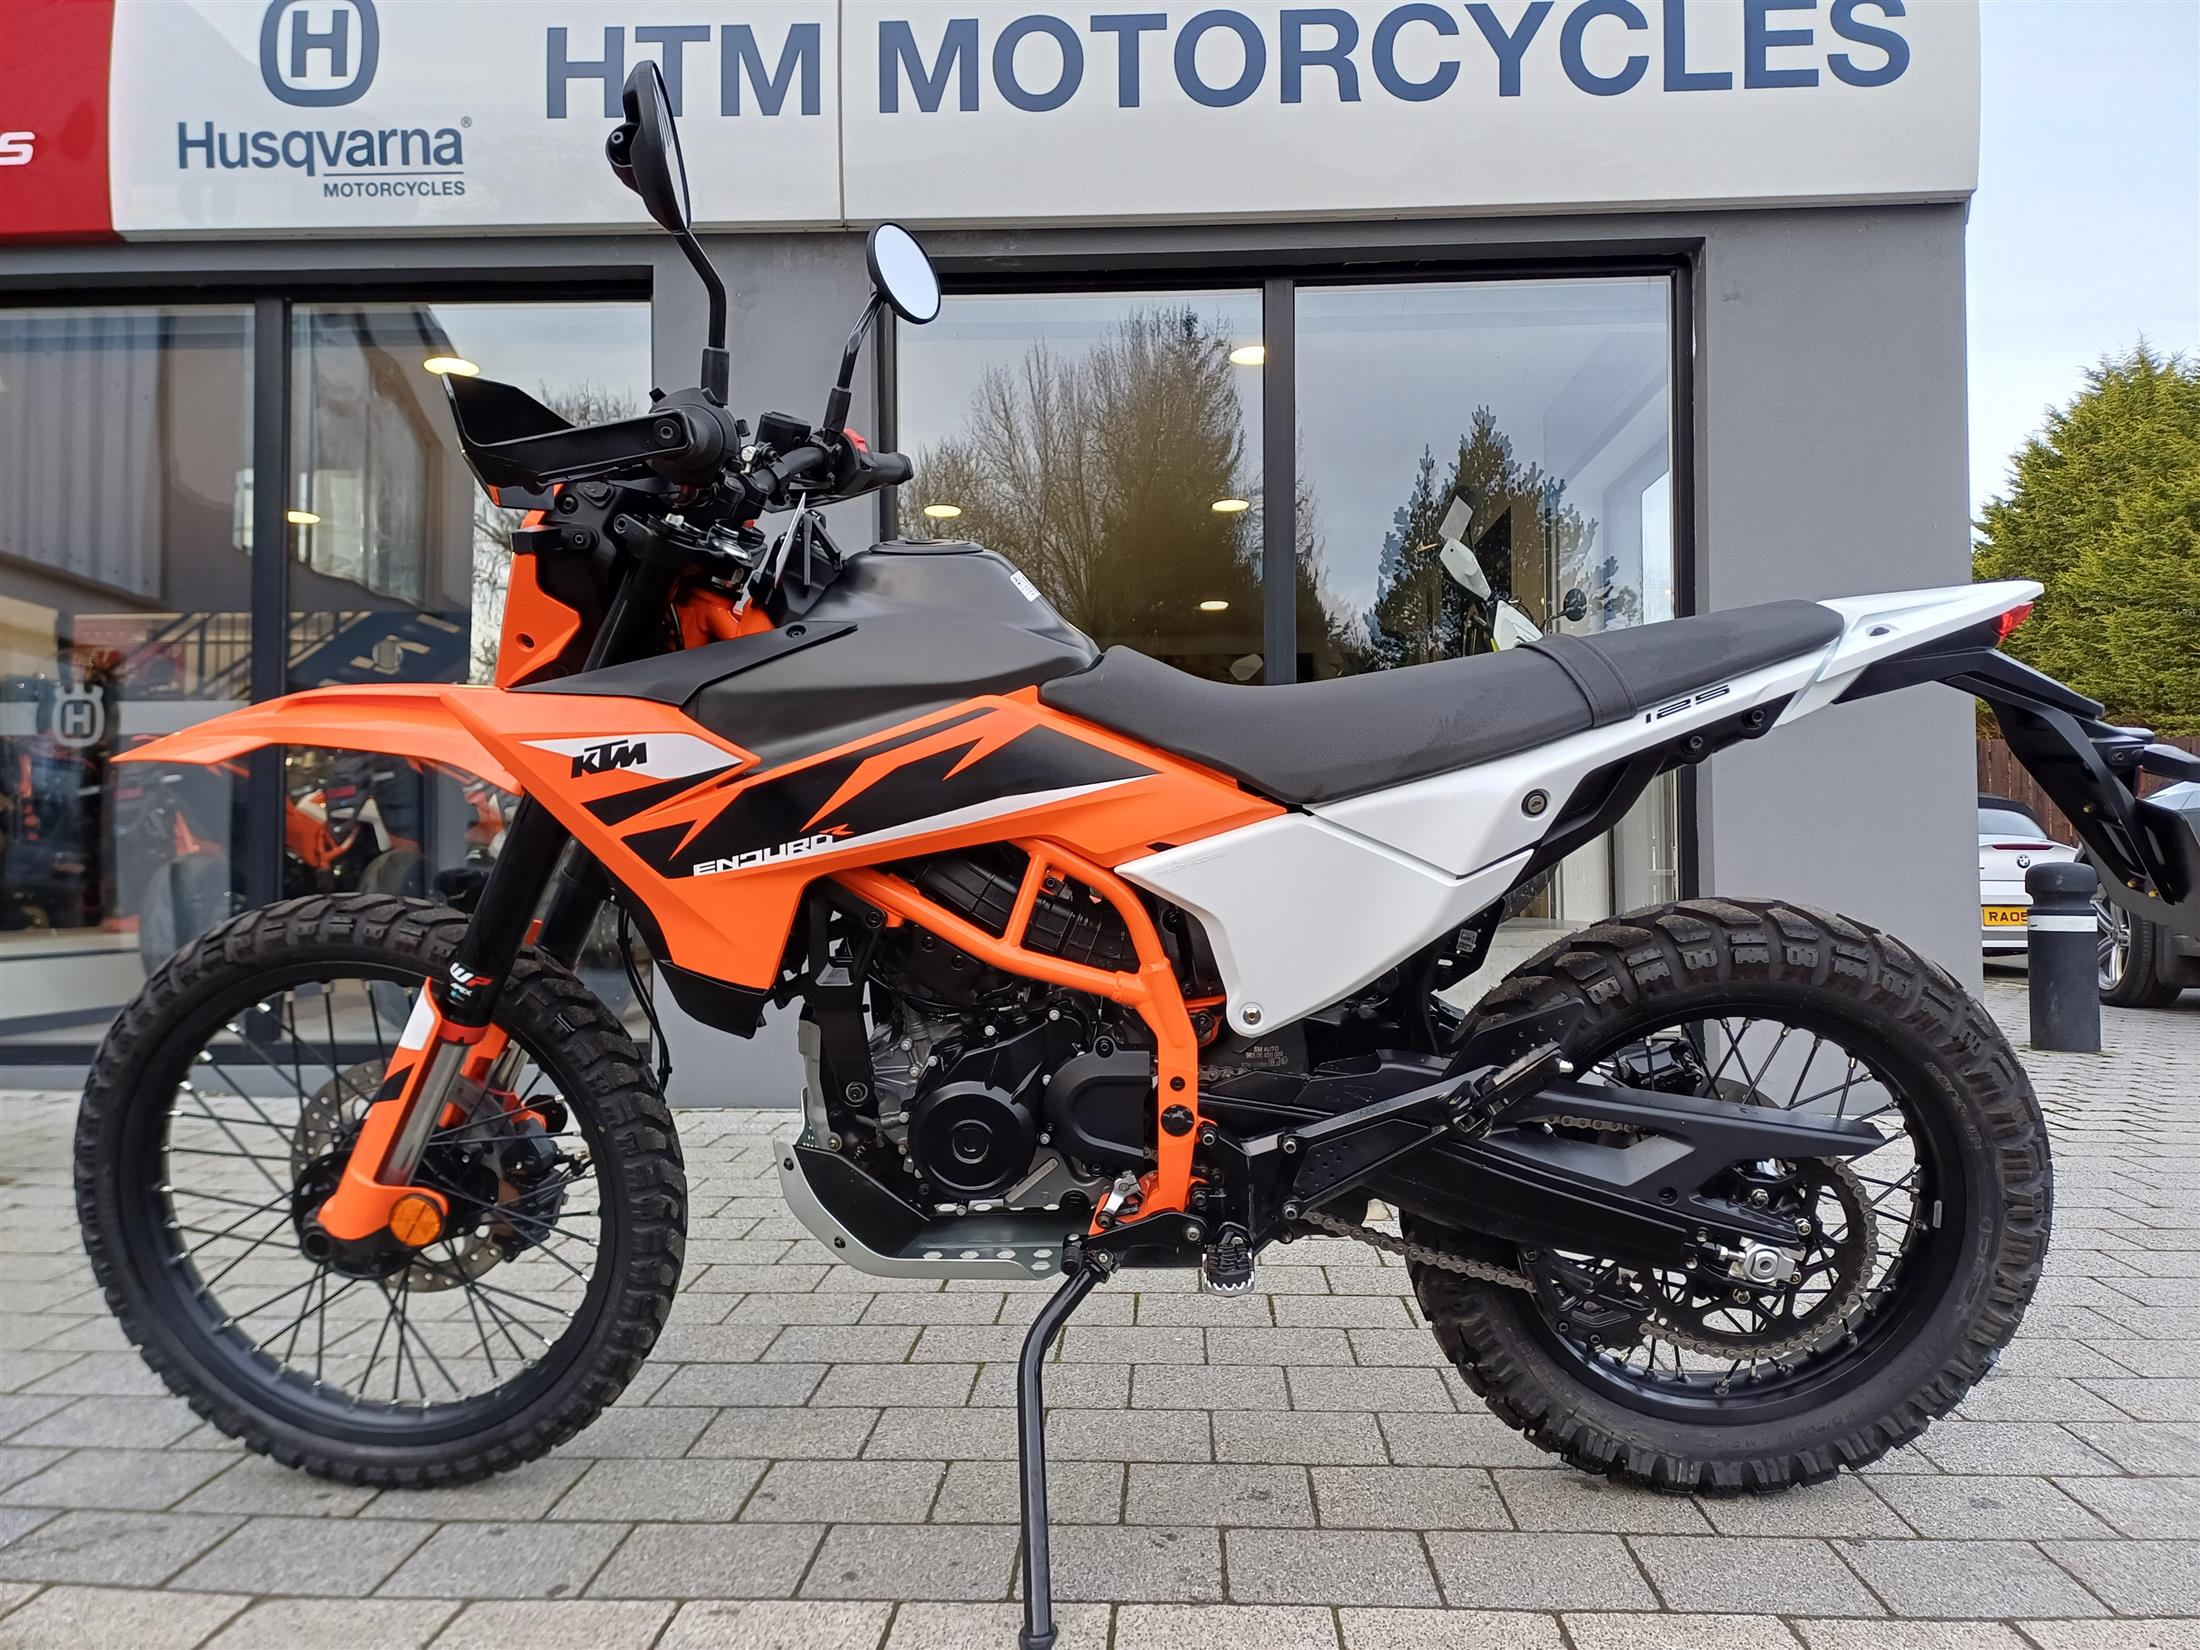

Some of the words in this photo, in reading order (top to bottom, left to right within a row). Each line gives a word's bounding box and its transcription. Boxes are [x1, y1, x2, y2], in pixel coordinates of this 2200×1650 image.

[546, 22, 821, 119] HTM
[878, 0, 1910, 113] MOTORCYCLES
[323, 180, 465, 197] MOTORCYCLES
[1645, 684, 1731, 724] 125
[570, 739, 648, 779] KTM
[692, 833, 834, 877] ENDURO
[450, 962, 492, 987] WP
